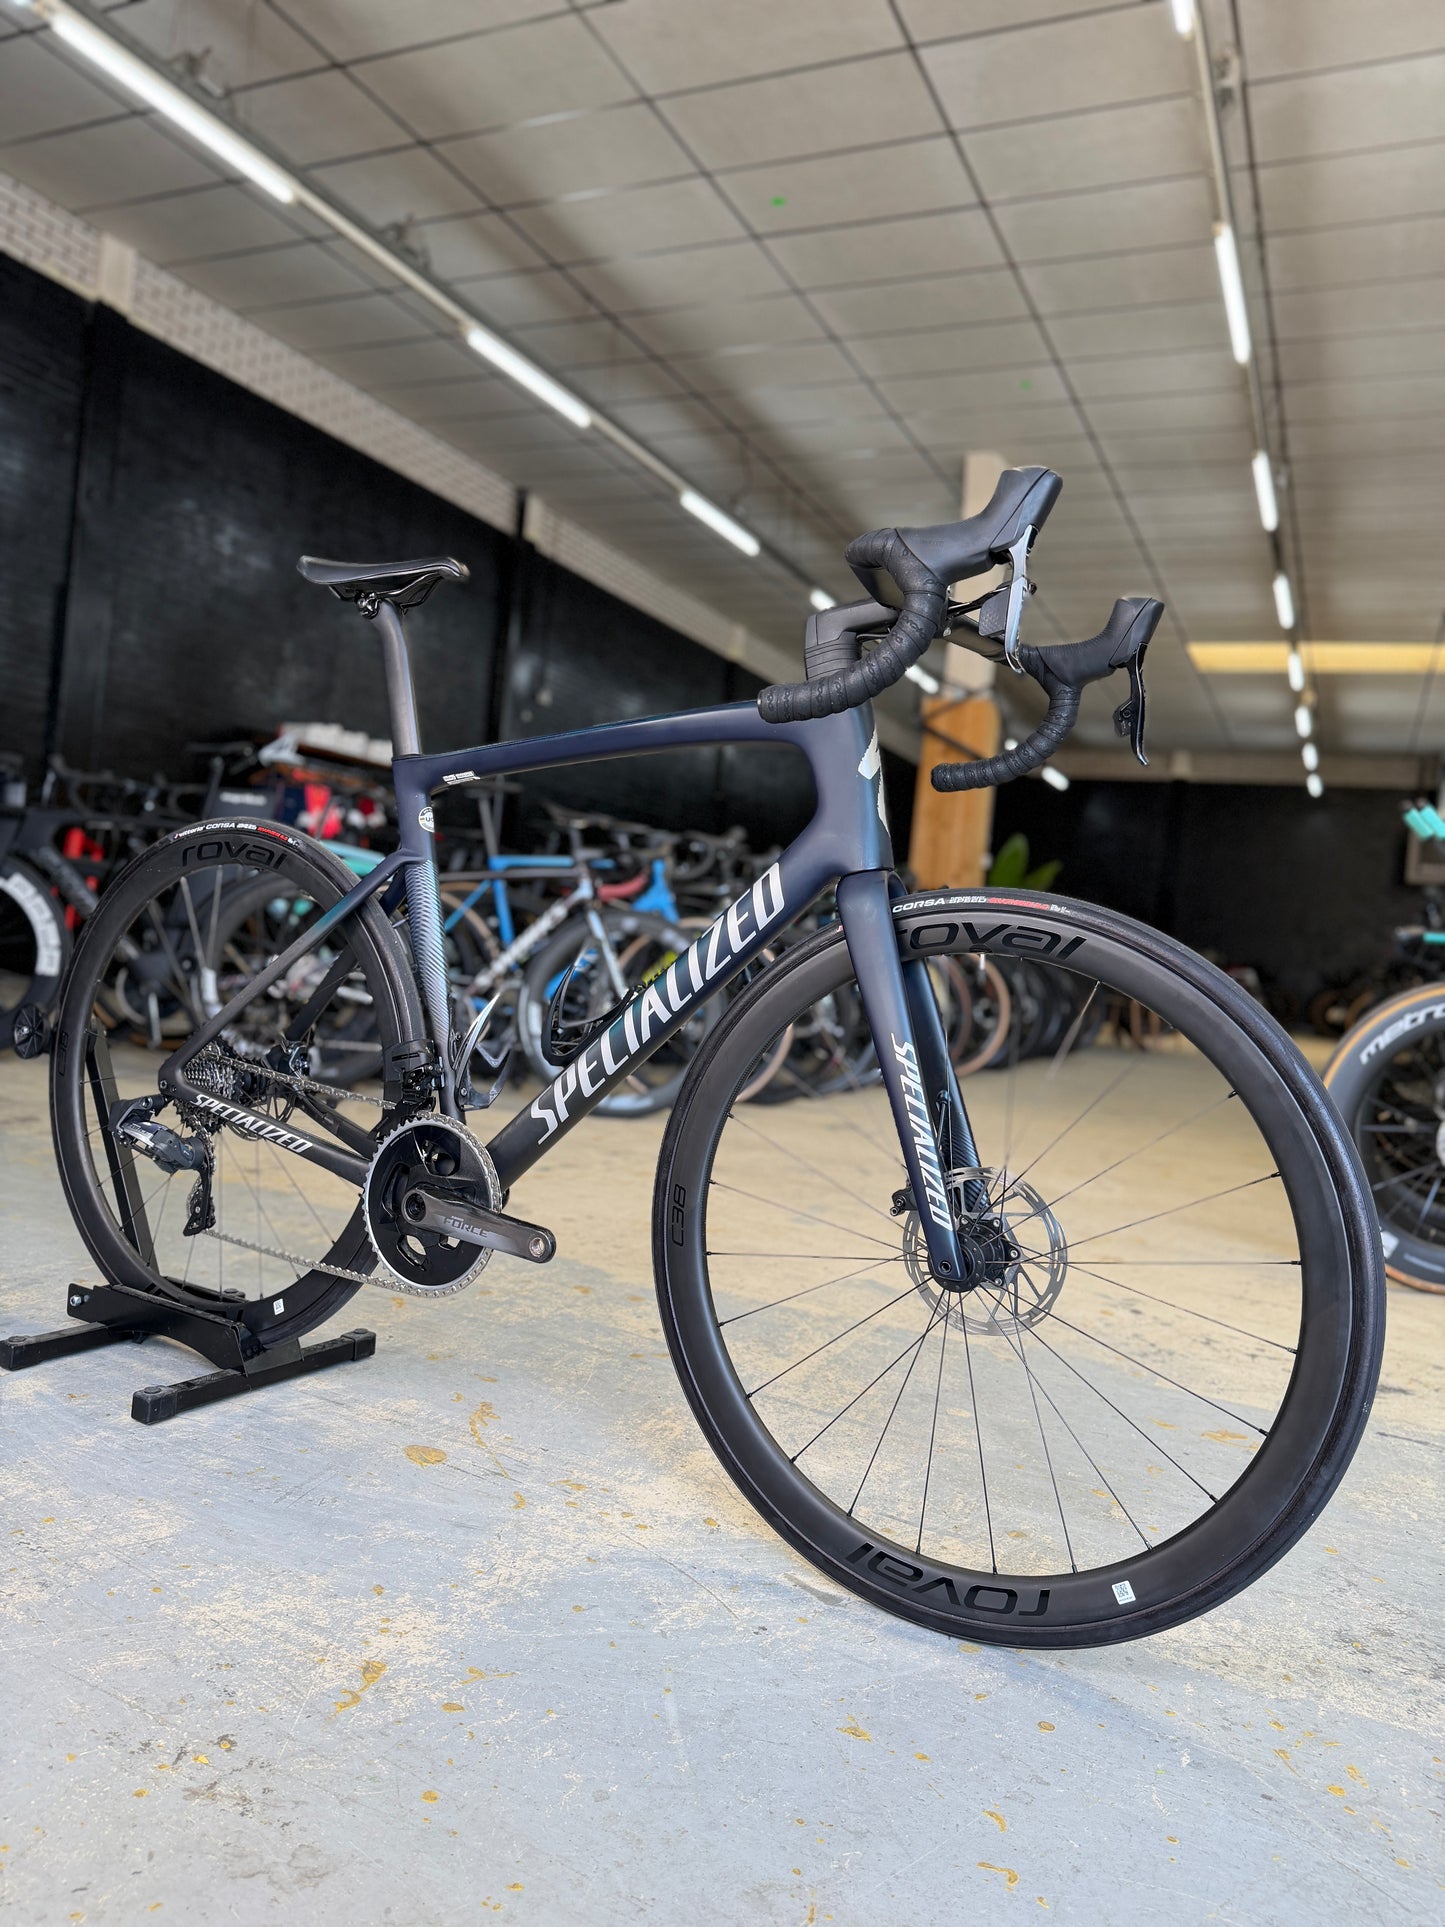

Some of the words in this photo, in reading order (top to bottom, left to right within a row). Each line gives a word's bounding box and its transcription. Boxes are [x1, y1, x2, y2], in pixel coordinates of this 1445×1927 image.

[205, 822, 236, 831] CORSA
[182, 841, 287, 870] roval
[892, 897, 946, 913] CORSA
[895, 921, 1088, 961] oval
[530, 862, 785, 1145] SPECIALIZED
[189, 1093, 313, 1153] SPECIALIZED
[890, 1033, 954, 1232] SPECIALIZED
[443, 1217, 490, 1238] FORCE
[671, 1183, 686, 1247] C38
[845, 1542, 1050, 1616] roval
